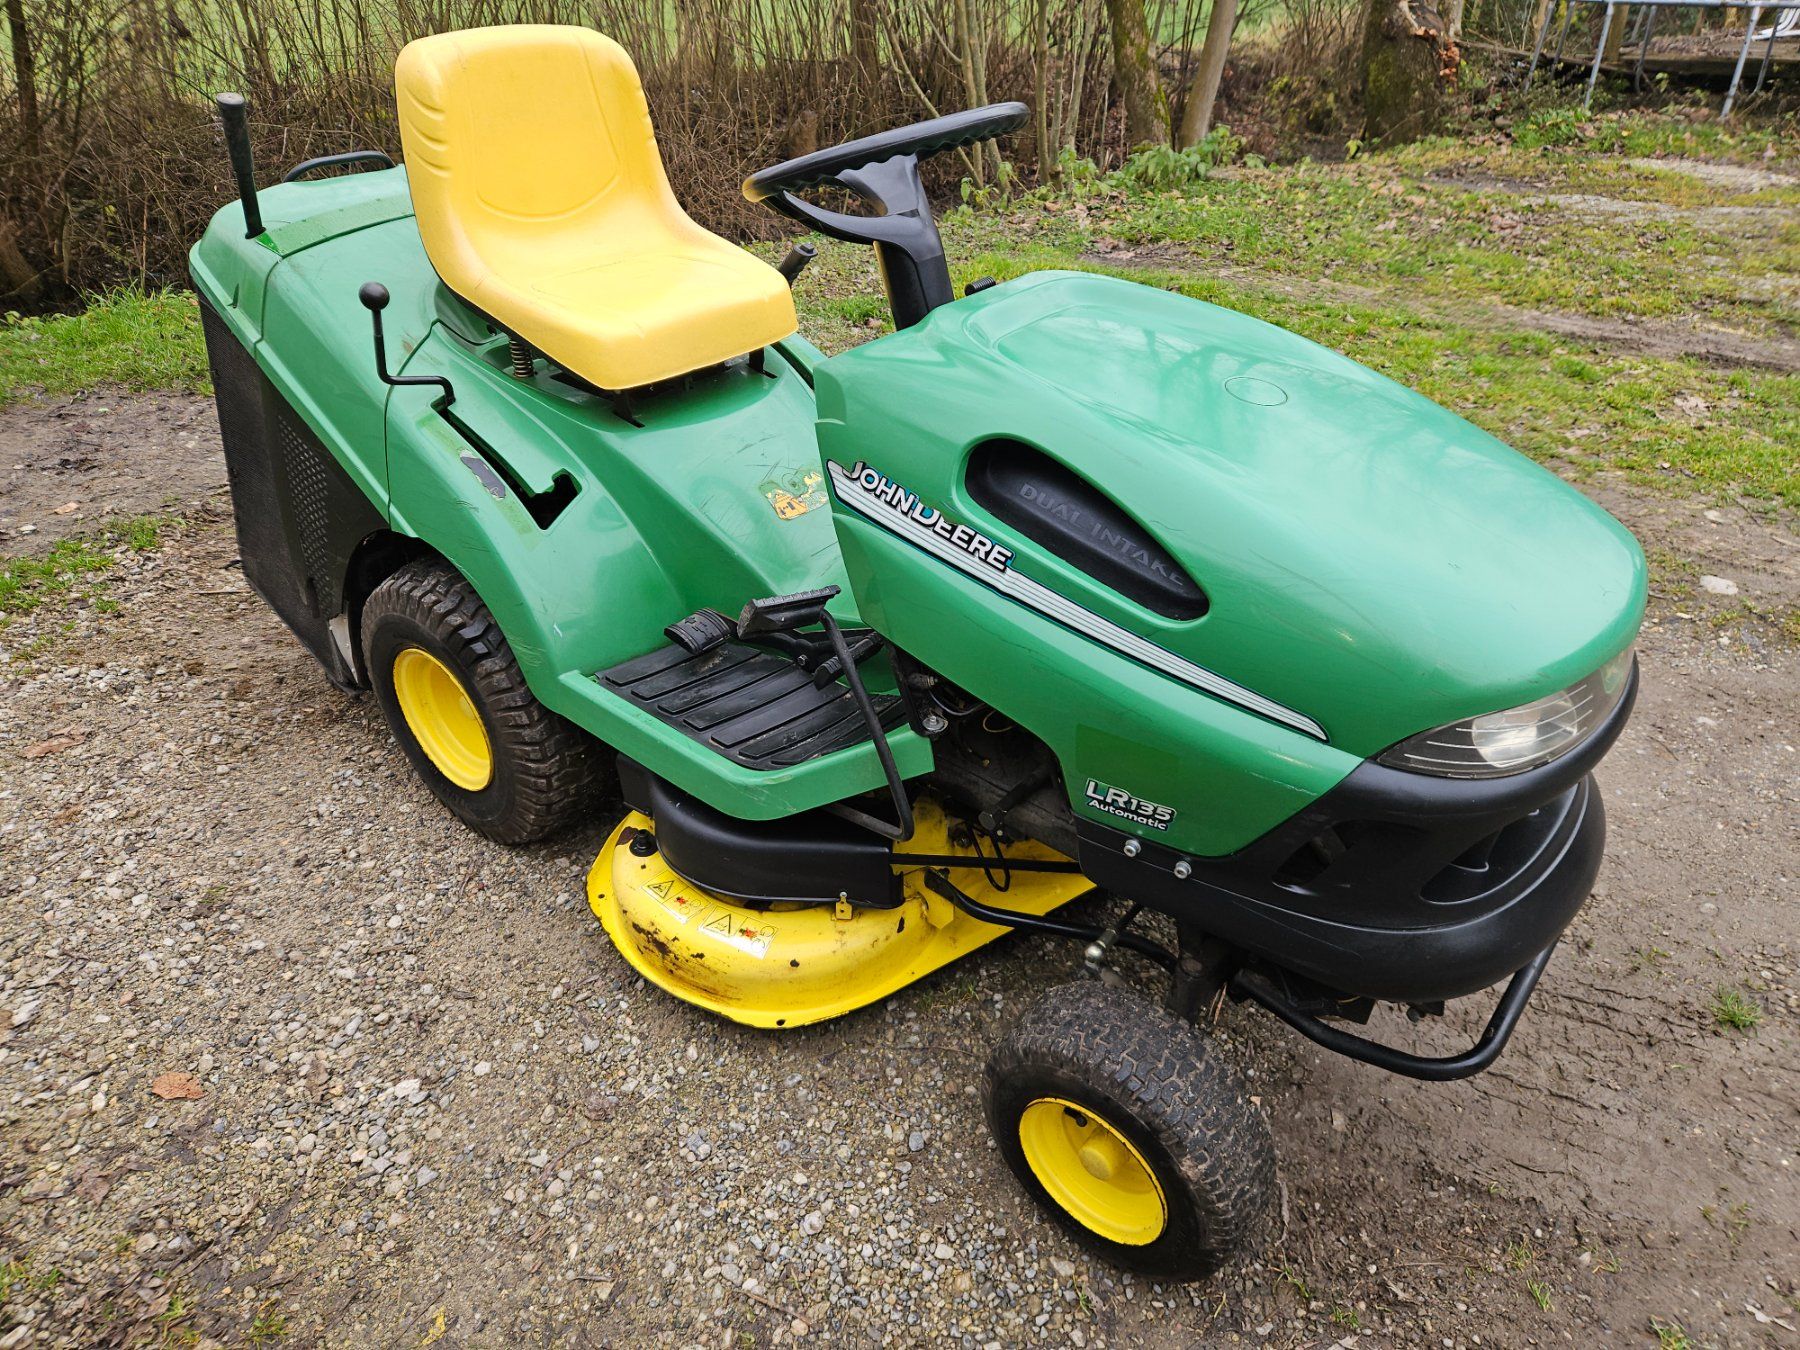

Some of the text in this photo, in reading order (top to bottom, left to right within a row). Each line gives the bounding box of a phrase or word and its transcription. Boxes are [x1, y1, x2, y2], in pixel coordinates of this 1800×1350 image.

[842, 461, 1012, 571] JOHN DEERE
[1020, 483, 1184, 587] DUAL INTAKE
[1086, 781, 1172, 821] LR135
[1088, 799, 1168, 831] Automatic
